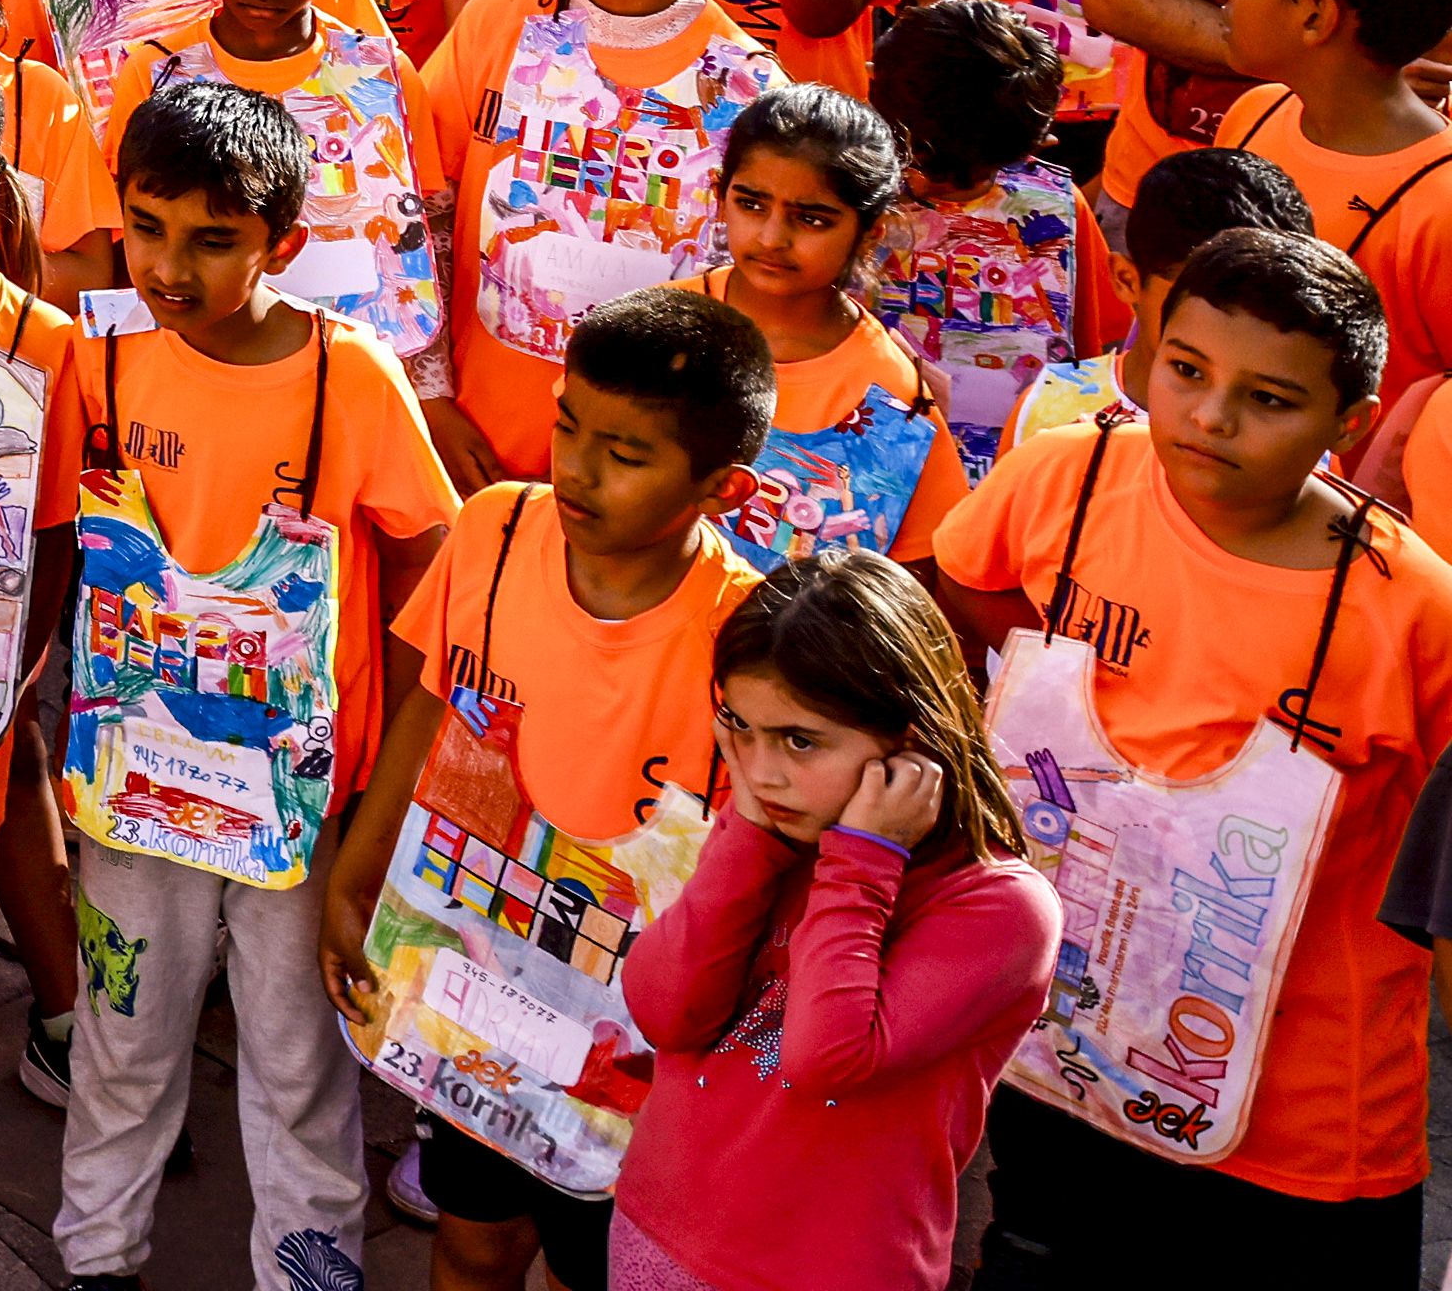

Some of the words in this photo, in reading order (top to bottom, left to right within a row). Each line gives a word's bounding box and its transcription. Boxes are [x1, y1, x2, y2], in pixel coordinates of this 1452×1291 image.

[516, 115, 686, 179] HARRO
[1125, 812, 1289, 1111] korrika
[1123, 1090, 1215, 1152] aek
